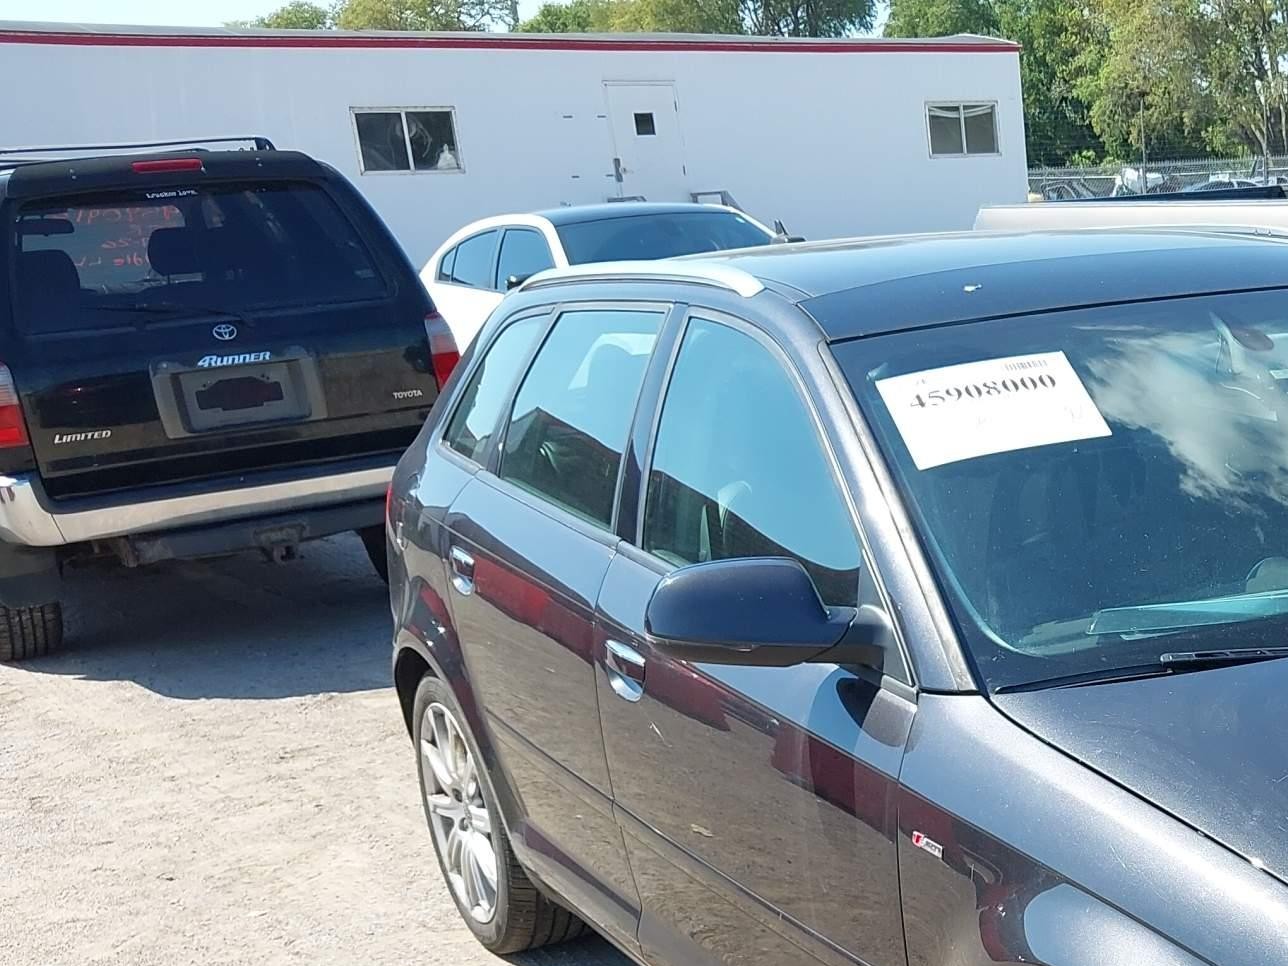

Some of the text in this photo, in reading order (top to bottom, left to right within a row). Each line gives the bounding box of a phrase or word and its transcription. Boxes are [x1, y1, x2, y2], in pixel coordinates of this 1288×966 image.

[392, 389, 423, 399] TOYOTA
[910, 374, 1056, 408] 45908000
[54, 430, 112, 444] LIMITED
